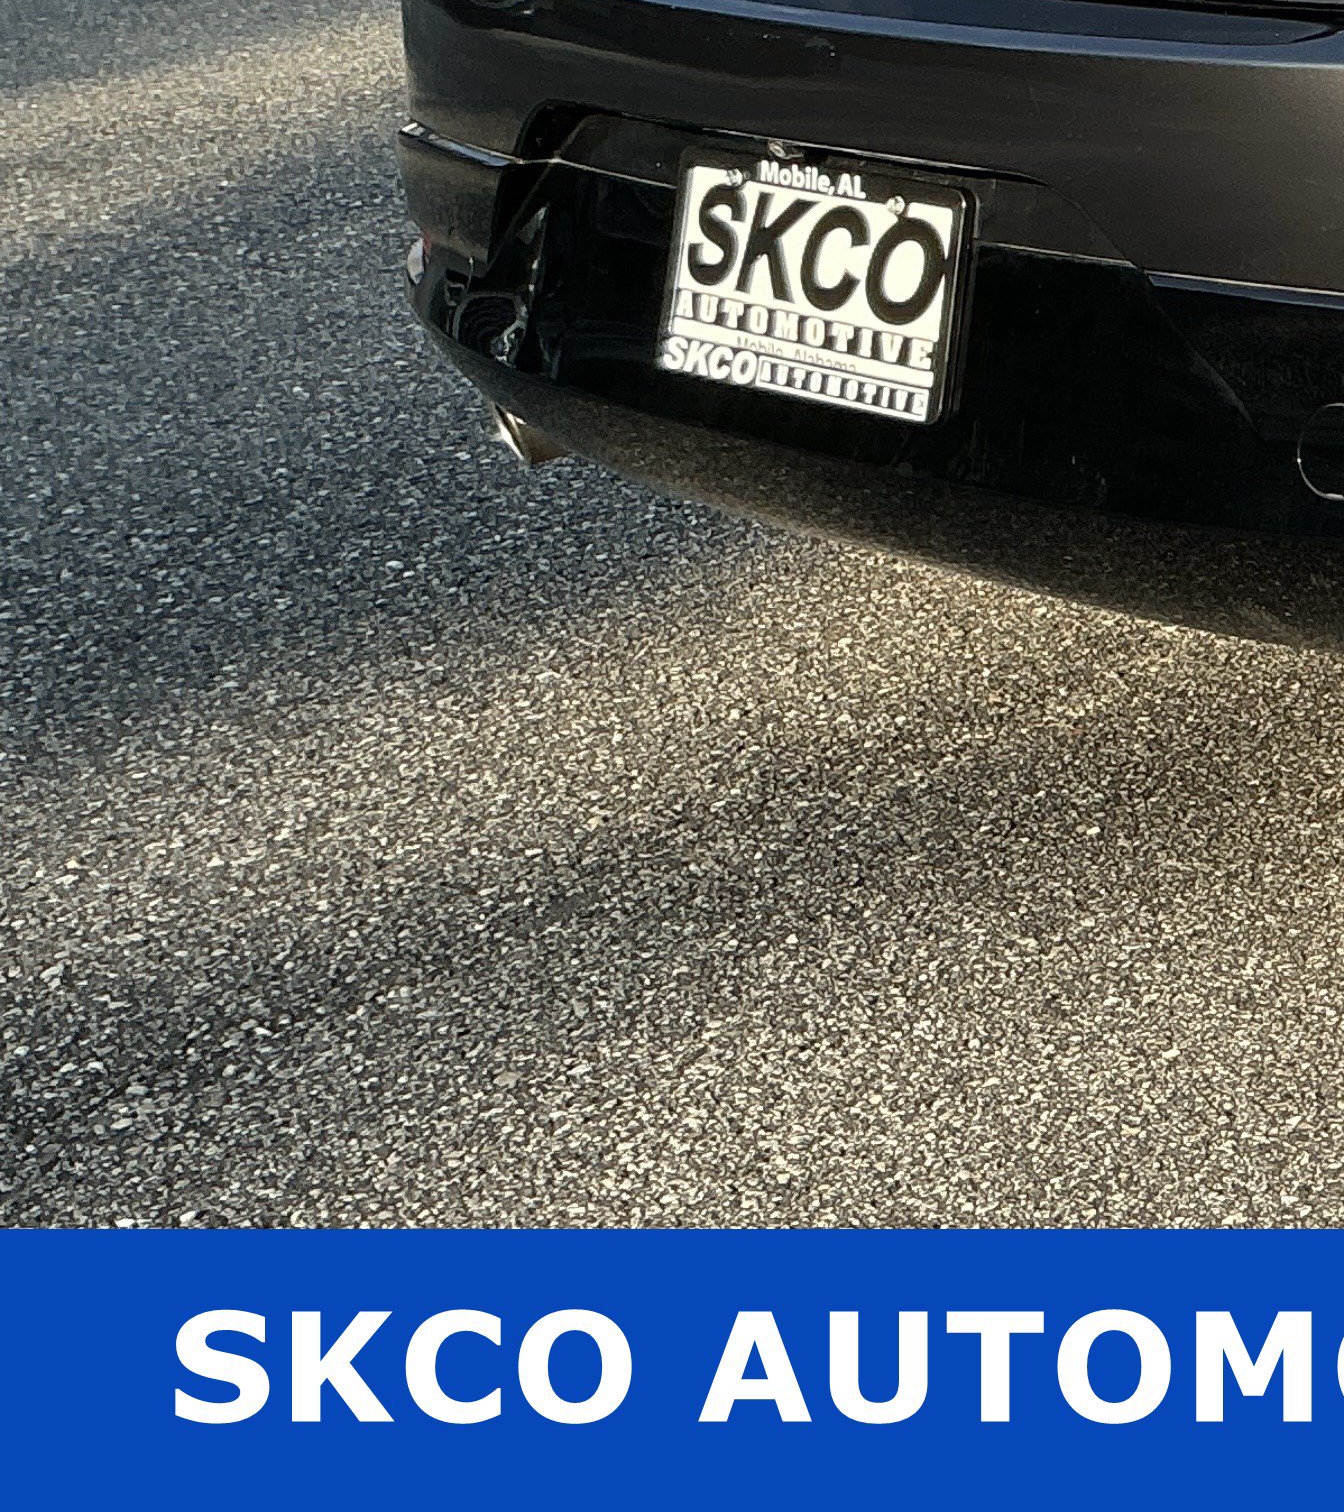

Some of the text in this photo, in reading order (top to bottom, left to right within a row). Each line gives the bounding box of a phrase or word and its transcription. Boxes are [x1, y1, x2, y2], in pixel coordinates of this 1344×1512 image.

[758, 159, 867, 199] Mobile, AL
[687, 183, 947, 326] SKCO
[674, 289, 938, 371] AUTOMOTIVE
[662, 335, 929, 417] SKCO AUTOMOTIVE
